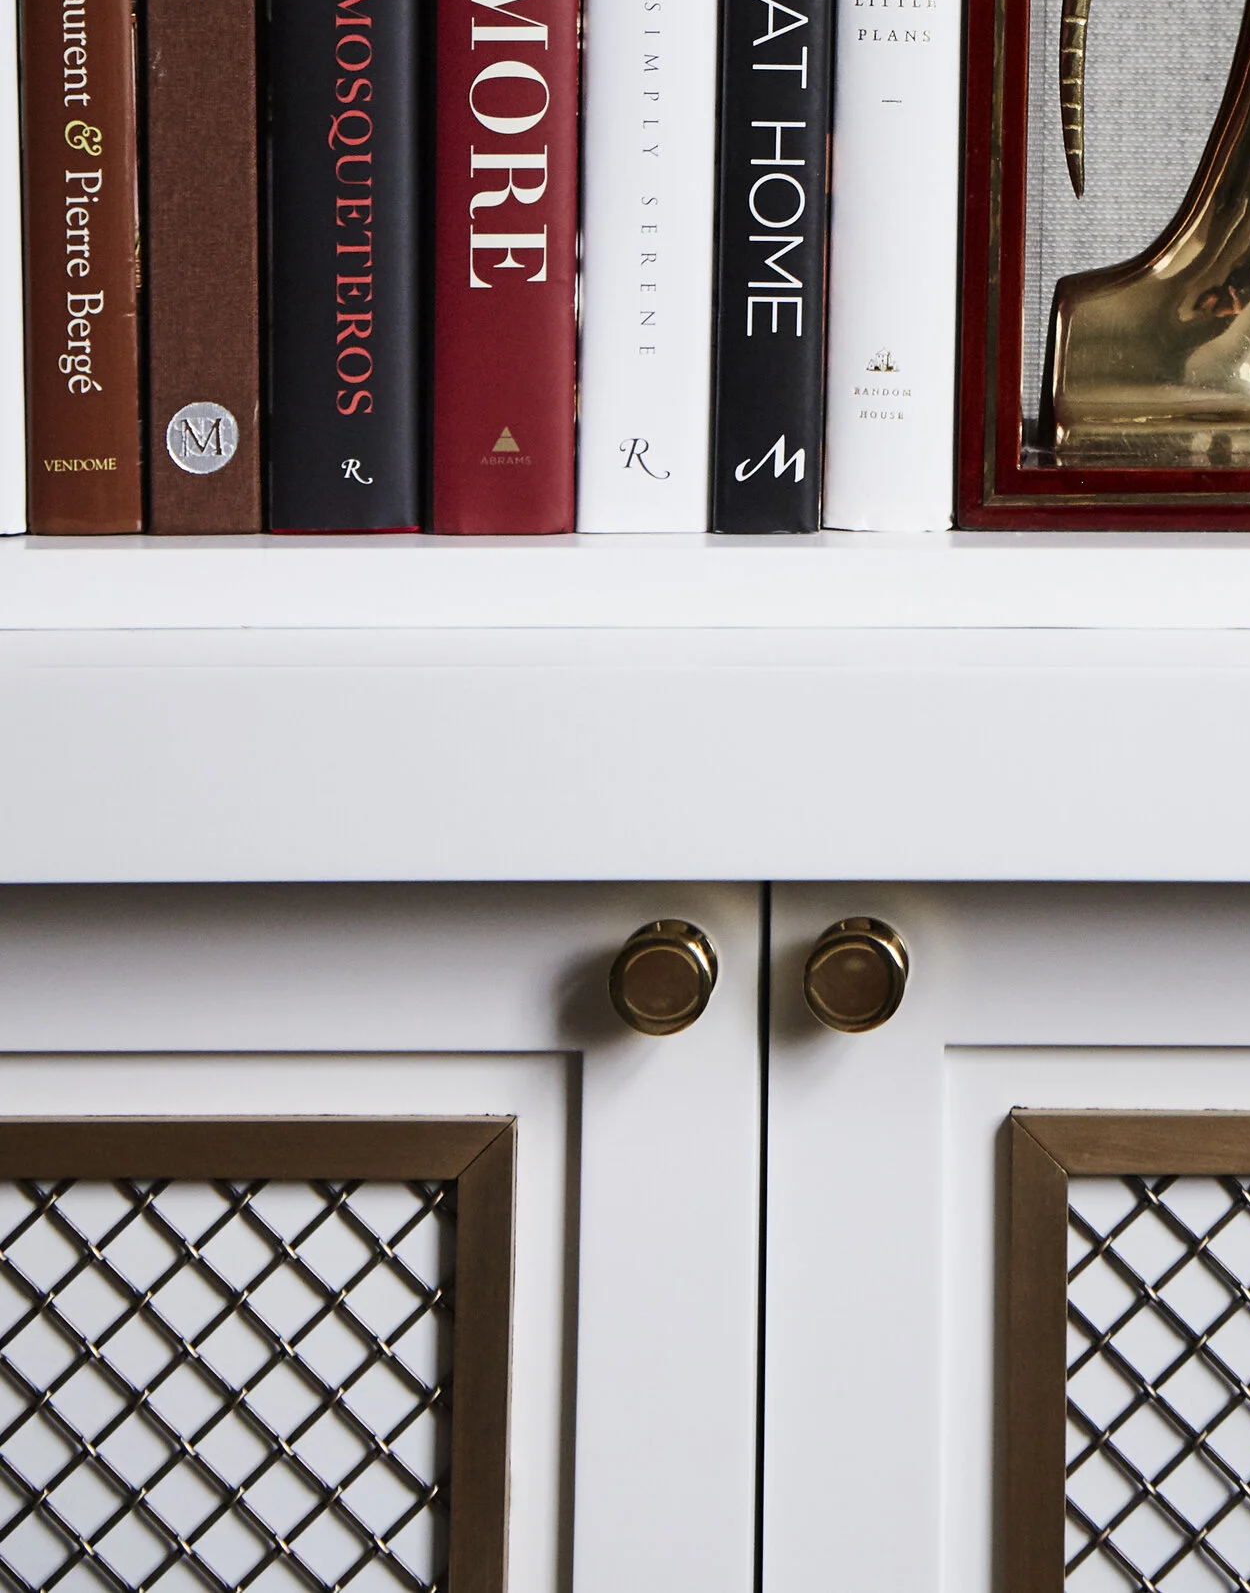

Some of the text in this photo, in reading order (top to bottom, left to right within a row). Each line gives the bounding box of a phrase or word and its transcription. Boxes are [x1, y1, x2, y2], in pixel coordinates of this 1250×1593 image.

[858, 29, 931, 41] PLANS
[65, 121, 102, 156] &
[638, 3, 660, 357] SIMPLY SERENE
[66, 169, 102, 277] Pierre
[748, 121, 806, 336] HOME
[59, 290, 104, 393] Bergé
[853, 386, 911, 397] RANDOM
[859, 410, 904, 420] HOUSE
[44, 458, 116, 471] VENDOME
[342, 459, 373, 484] R
[480, 456, 532, 466] ABRAMS
[620, 439, 670, 478] R
